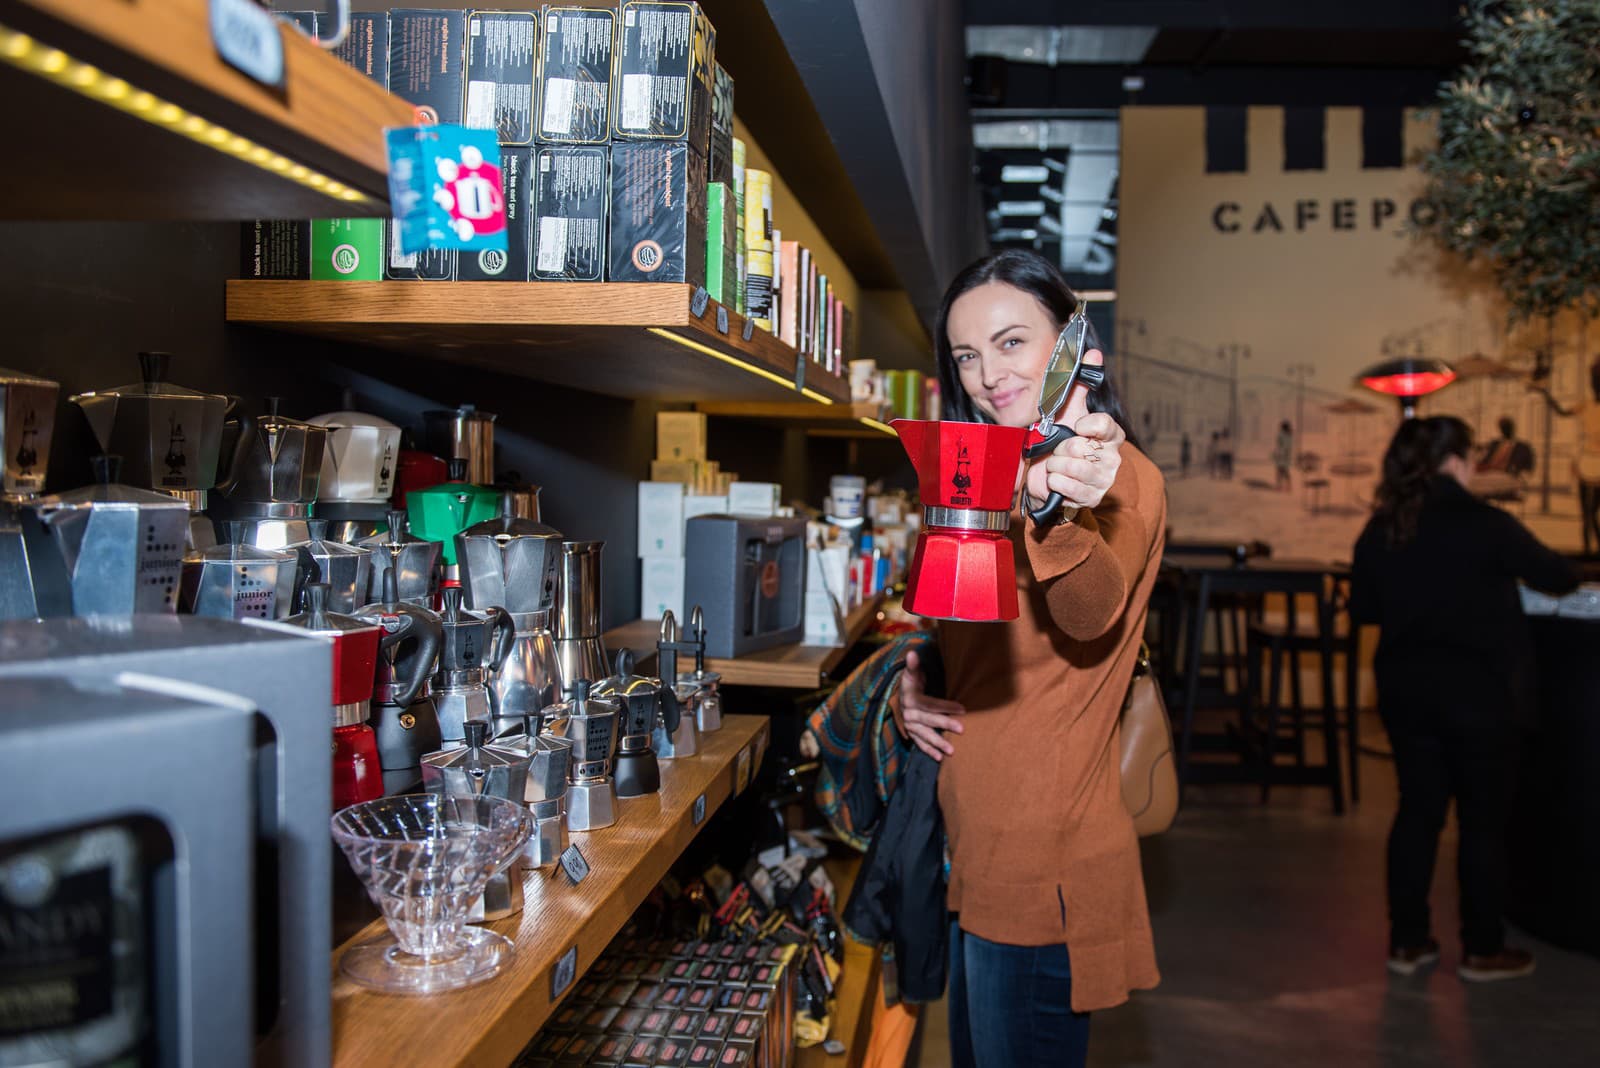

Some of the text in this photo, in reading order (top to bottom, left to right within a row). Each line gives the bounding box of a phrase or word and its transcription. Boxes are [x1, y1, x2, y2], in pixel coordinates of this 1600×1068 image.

[366, 19, 374, 75] english breakfast
[440, 42, 448, 74] breakfast
[510, 155, 518, 175] black
[508, 203, 516, 219] grey
[236, 590, 273, 602] junior
